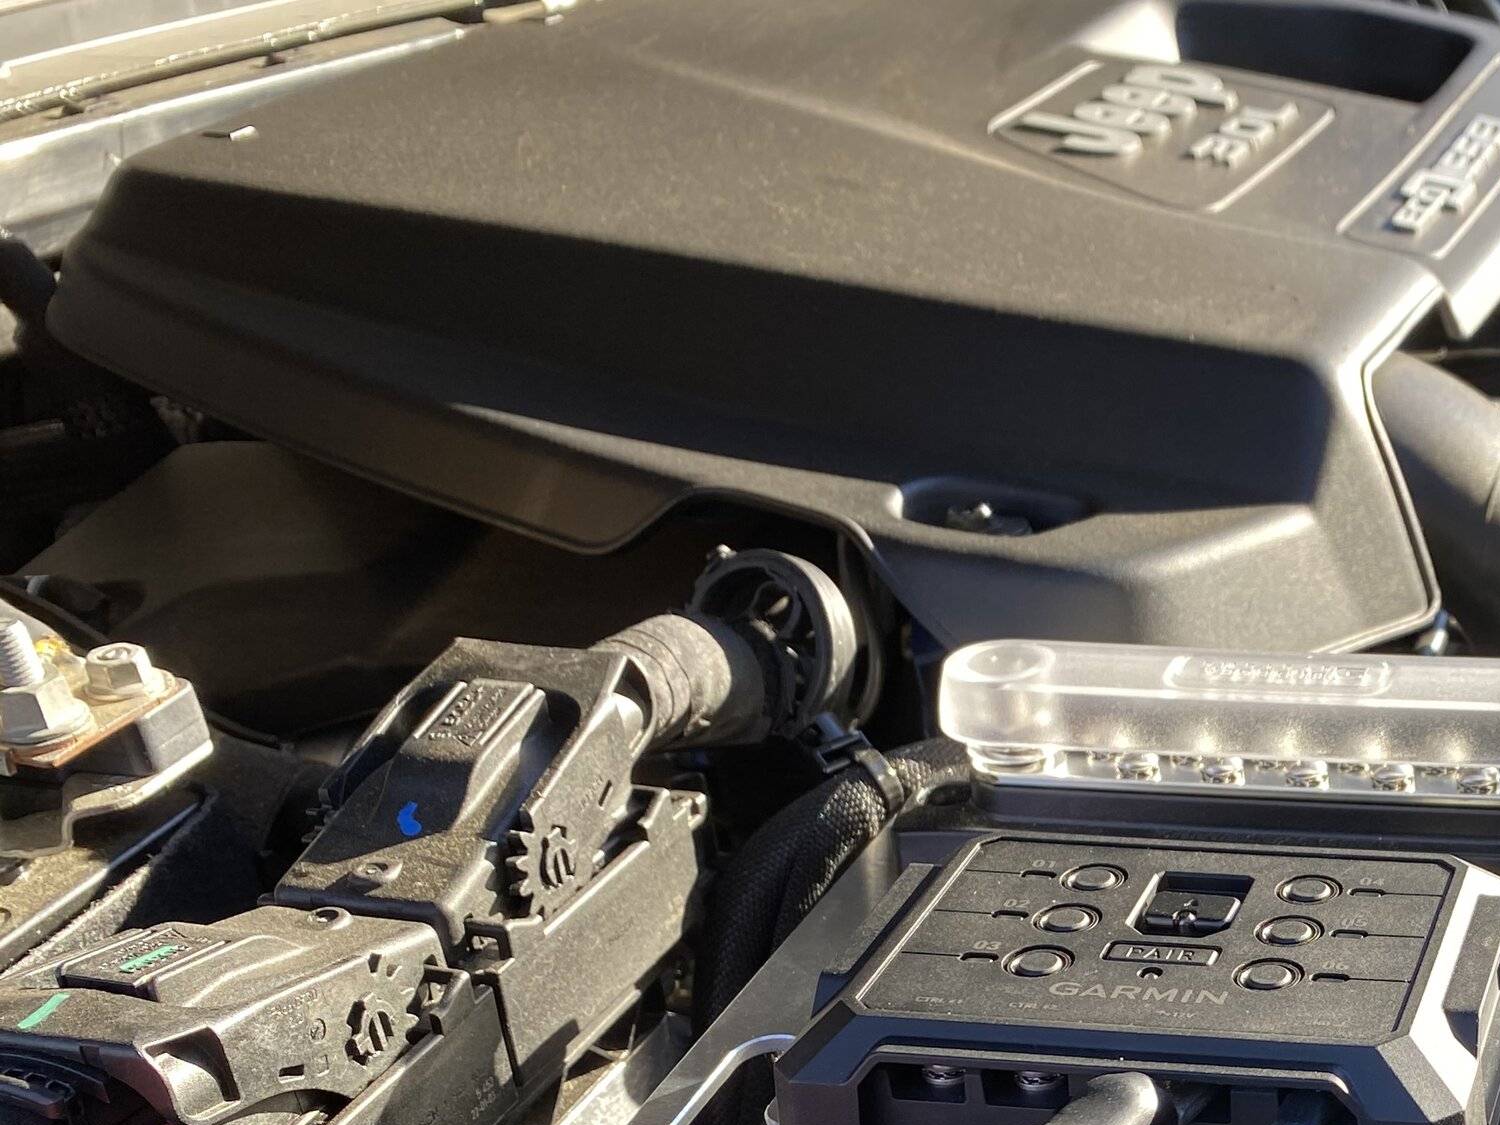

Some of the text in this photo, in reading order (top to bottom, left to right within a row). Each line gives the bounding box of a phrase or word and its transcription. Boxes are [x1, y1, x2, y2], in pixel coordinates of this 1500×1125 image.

[1032, 859, 1057, 868] 01
[1359, 877, 1386, 887] 04
[1003, 898, 1029, 909] 02
[973, 940, 1001, 951] 03
[1125, 945, 1196, 962] PAIR
[1049, 981, 1230, 1006] GARMIN
